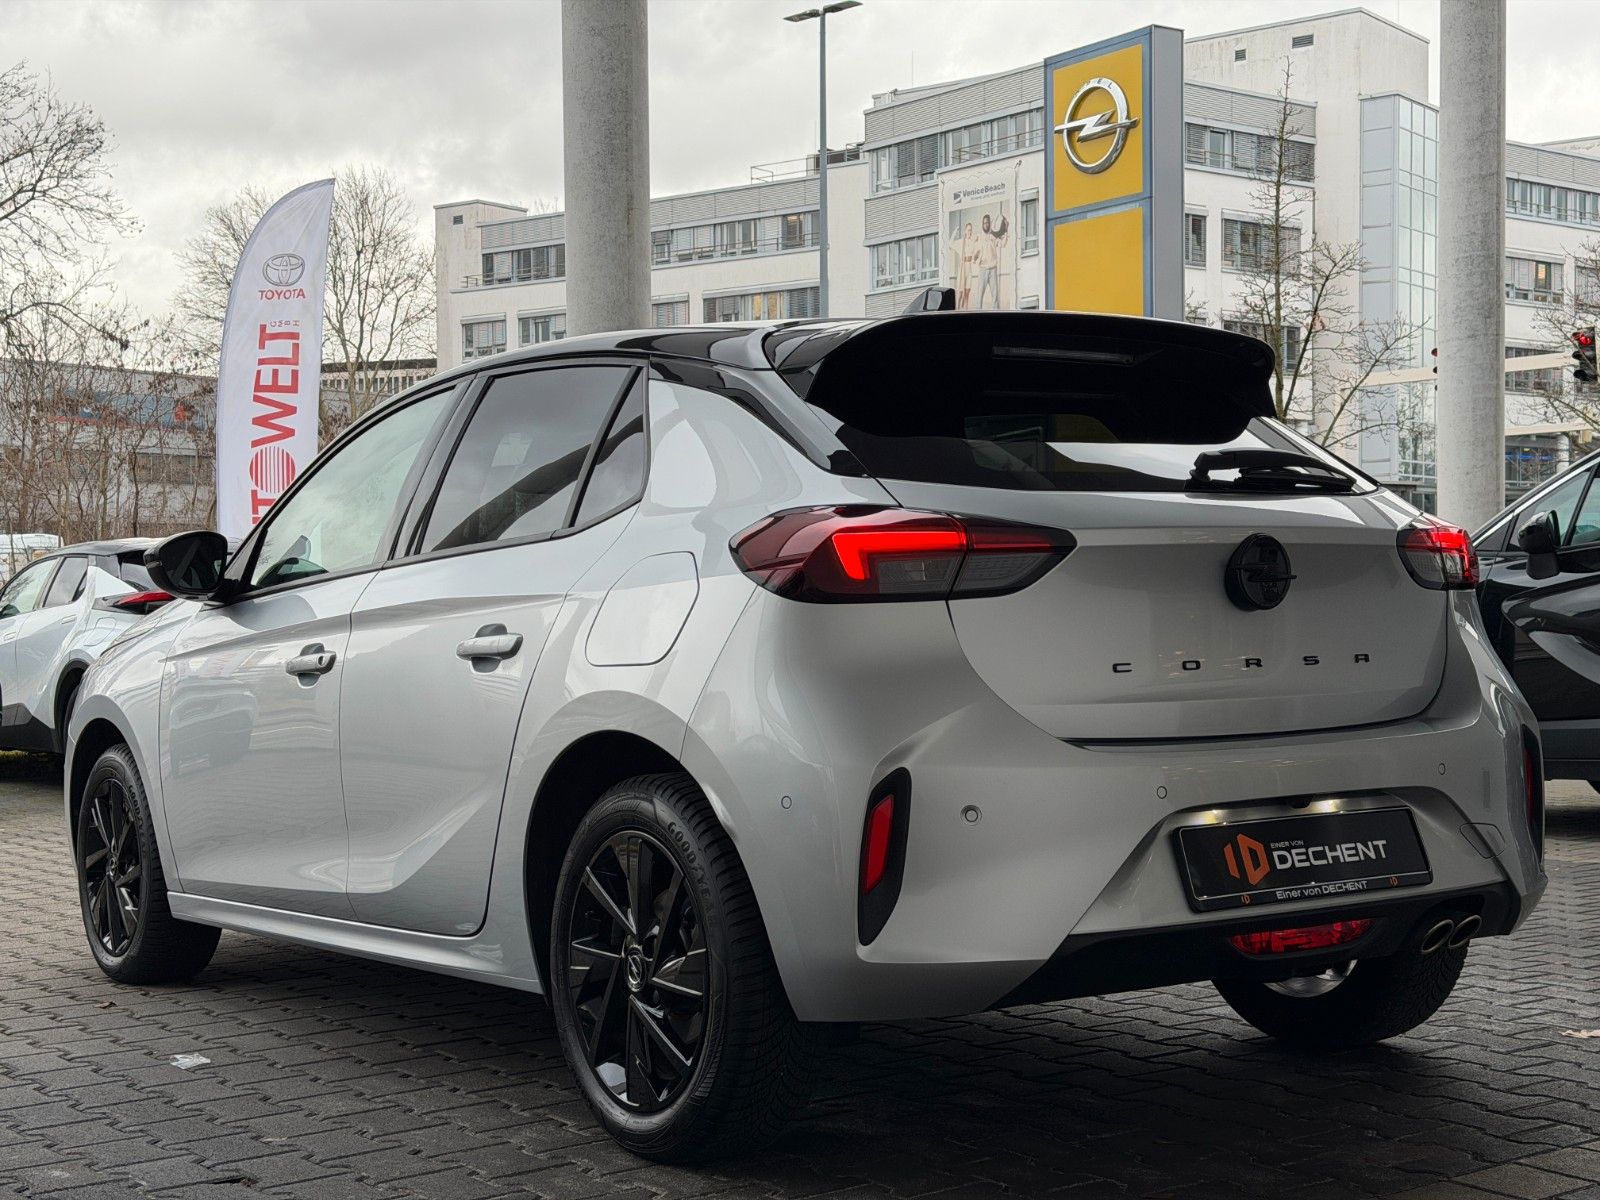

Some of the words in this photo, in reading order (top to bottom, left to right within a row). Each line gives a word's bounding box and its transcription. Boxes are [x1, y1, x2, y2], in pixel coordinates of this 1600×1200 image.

[258, 288, 306, 300] TOYOTA
[249, 323, 300, 525] TOWELT
[1270, 841, 1290, 849] EINER
[1290, 839, 1304, 847] VON
[1272, 839, 1387, 870] DECHENT
[1276, 890, 1301, 899] Einer
[1302, 888, 1322, 896] von
[1323, 881, 1367, 893] DECHENT
